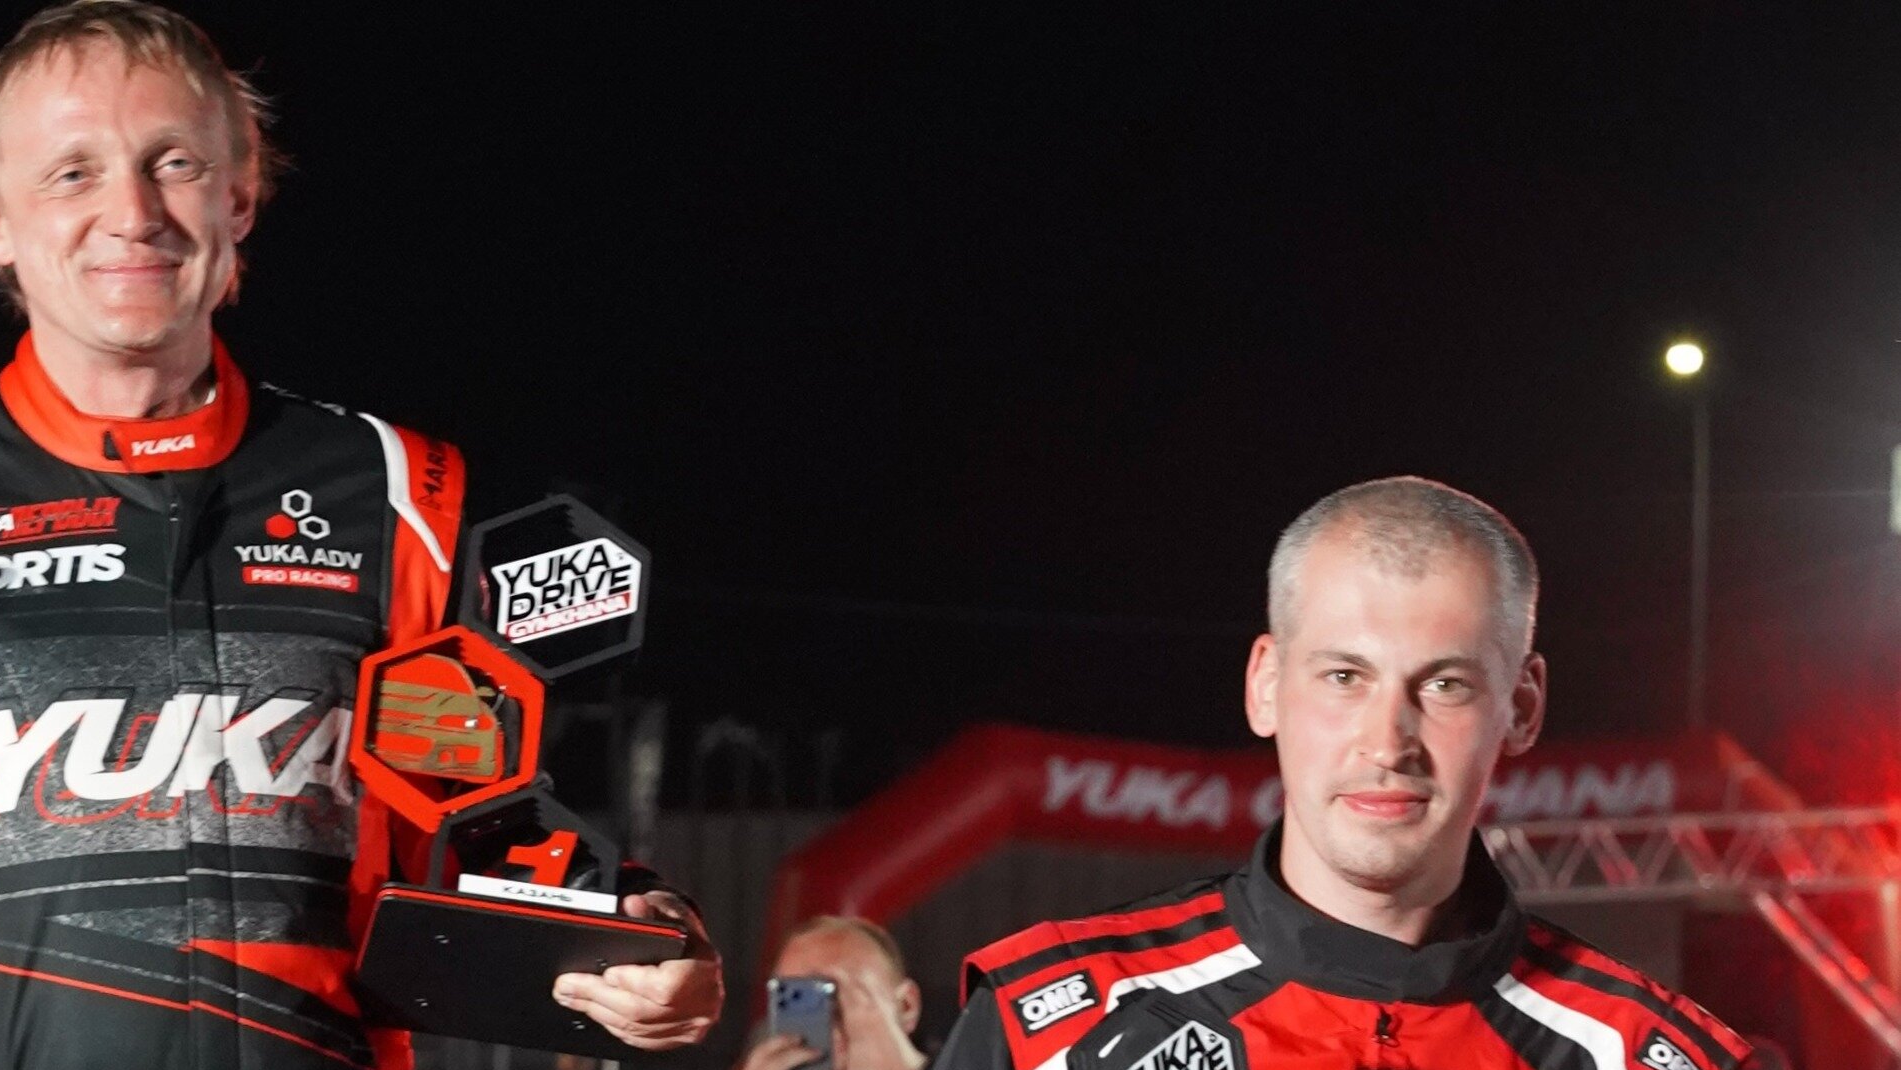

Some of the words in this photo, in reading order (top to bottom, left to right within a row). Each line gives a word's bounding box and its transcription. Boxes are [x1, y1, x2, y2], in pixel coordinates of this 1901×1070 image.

[131, 433, 196, 457] YUKA
[234, 543, 309, 563] YUKA
[310, 547, 363, 570] ADV
[251, 568, 288, 582] PRO
[289, 570, 352, 589] RACING
[502, 544, 611, 595] YUKA
[508, 564, 632, 622] DRIVE
[508, 595, 629, 639] GYMKHANA
[1044, 755, 1231, 831] YUKA
[505, 829, 579, 888] 1
[503, 884, 574, 903] КАЗАНЬ
[1022, 979, 1088, 1023] OMP
